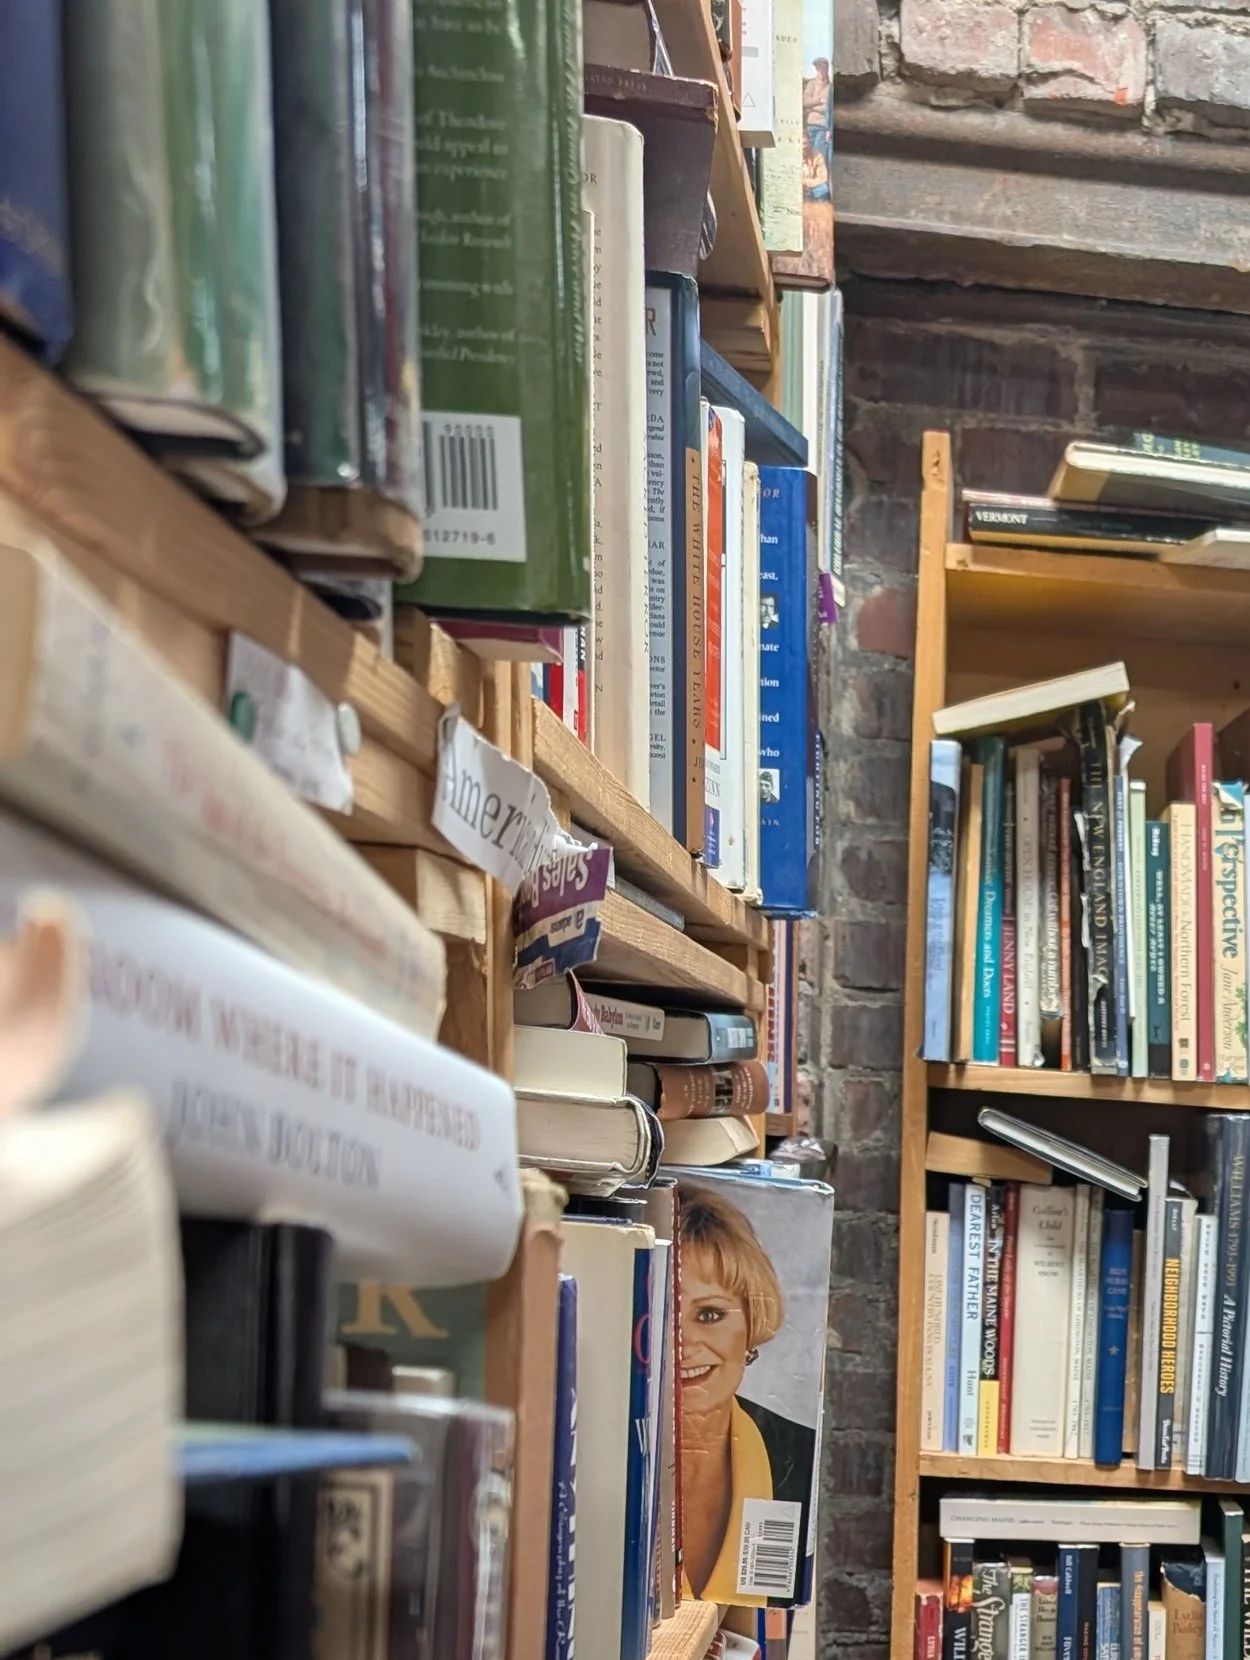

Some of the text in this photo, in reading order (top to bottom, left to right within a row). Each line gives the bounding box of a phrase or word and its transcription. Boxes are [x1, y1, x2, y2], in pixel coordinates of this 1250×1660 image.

[975, 511, 1029, 526] VERMONT
[691, 473, 702, 729] THE WHITE HOUSE YEARS
[1220, 964, 1238, 1050] Jane Anderson
[967, 1194, 982, 1320] DEAREST FATHER
[983, 1239, 999, 1375] IN THE MAINE WOODS
[1160, 1258, 1179, 1393] NEIGHBORHOOD HEROES
[966, 1370, 977, 1396] Hunt
[973, 1570, 996, 1595] The
[970, 1596, 1004, 1660] Strange
